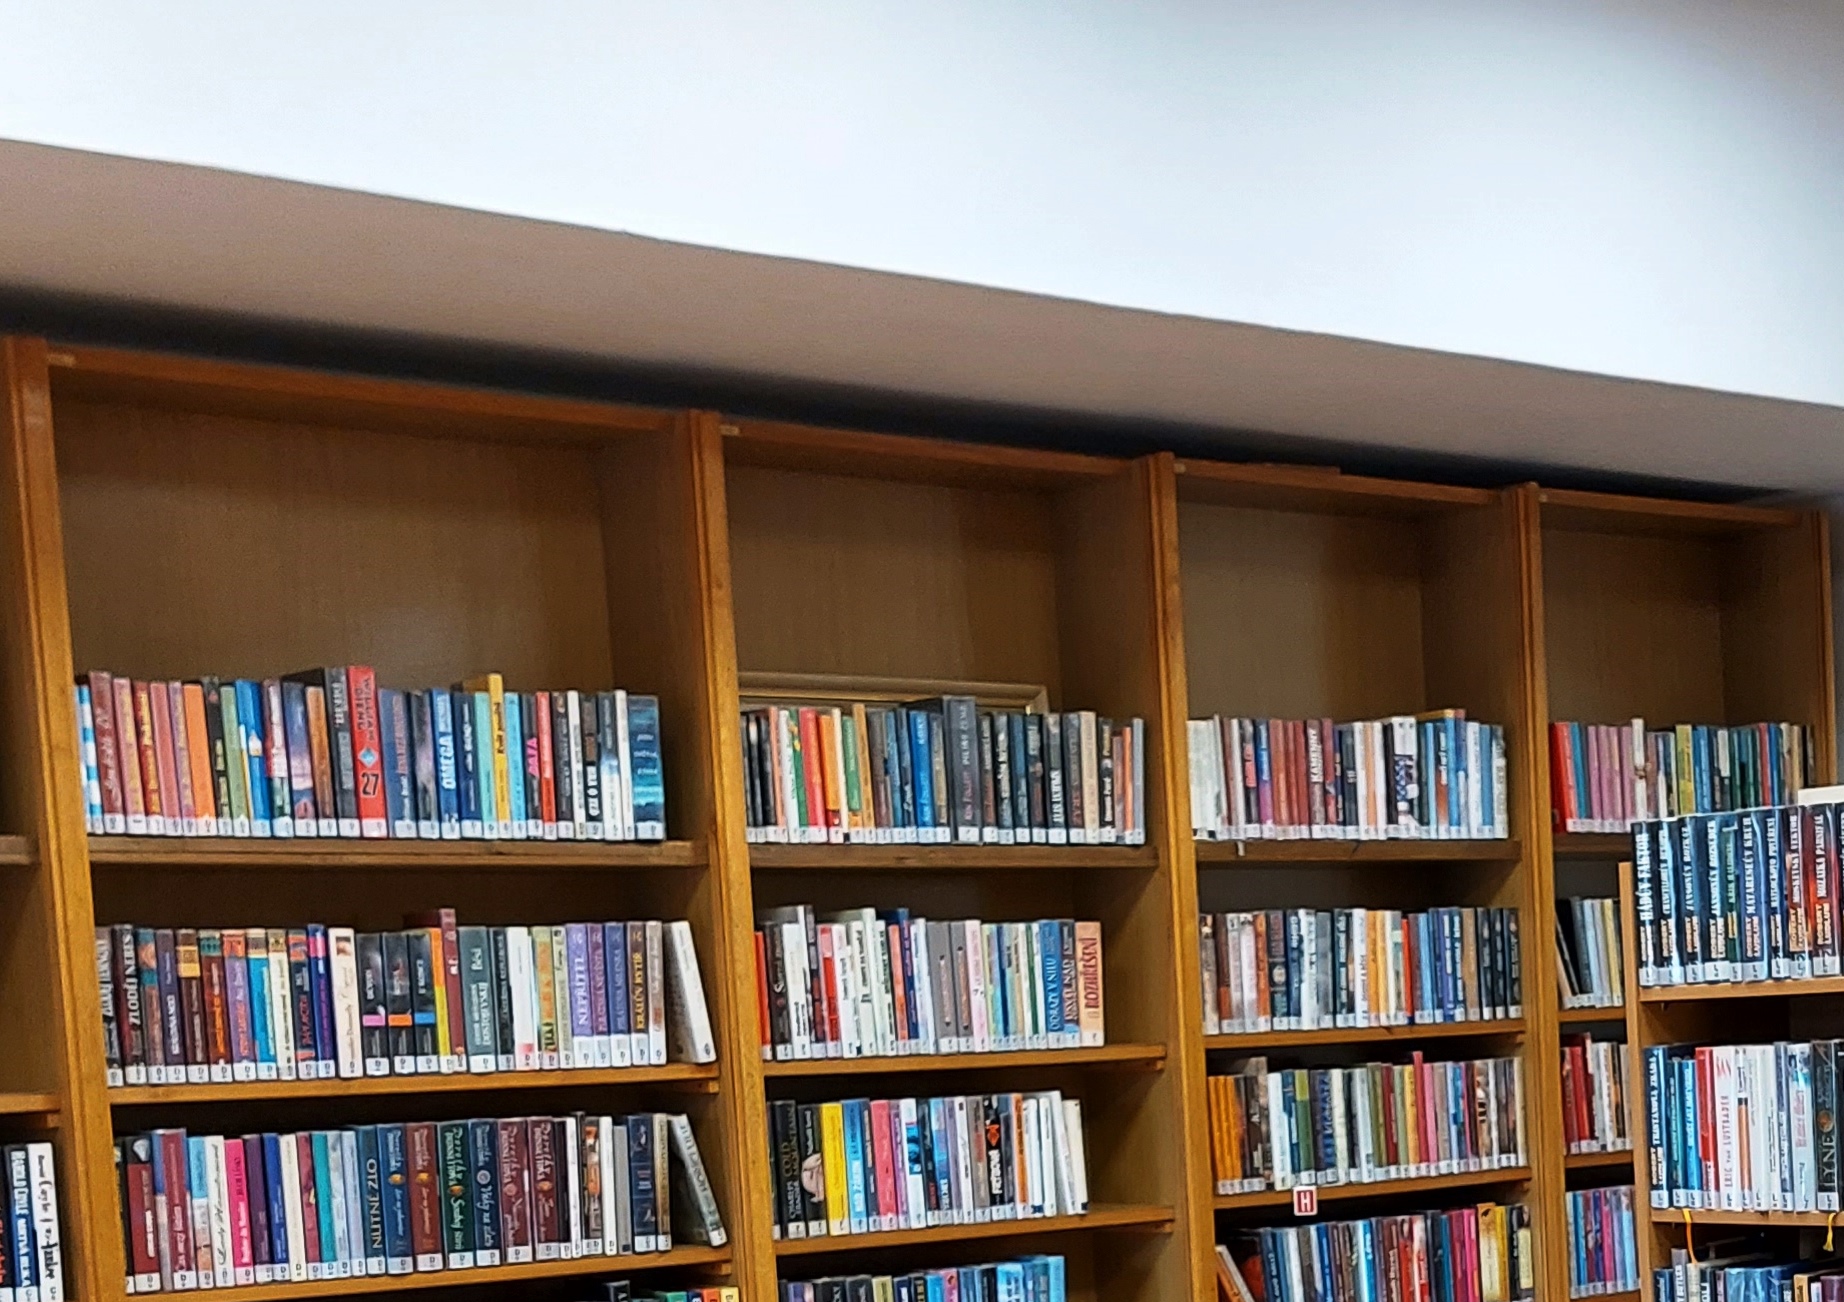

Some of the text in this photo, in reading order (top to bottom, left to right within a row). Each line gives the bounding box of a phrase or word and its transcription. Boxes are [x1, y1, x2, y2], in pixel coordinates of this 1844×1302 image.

[439, 735, 455, 789] OMEGA
[362, 772, 379, 796] 27
[367, 1159, 383, 1248] NUTNÉ ZLO
[1300, 1191, 1310, 1213] H
